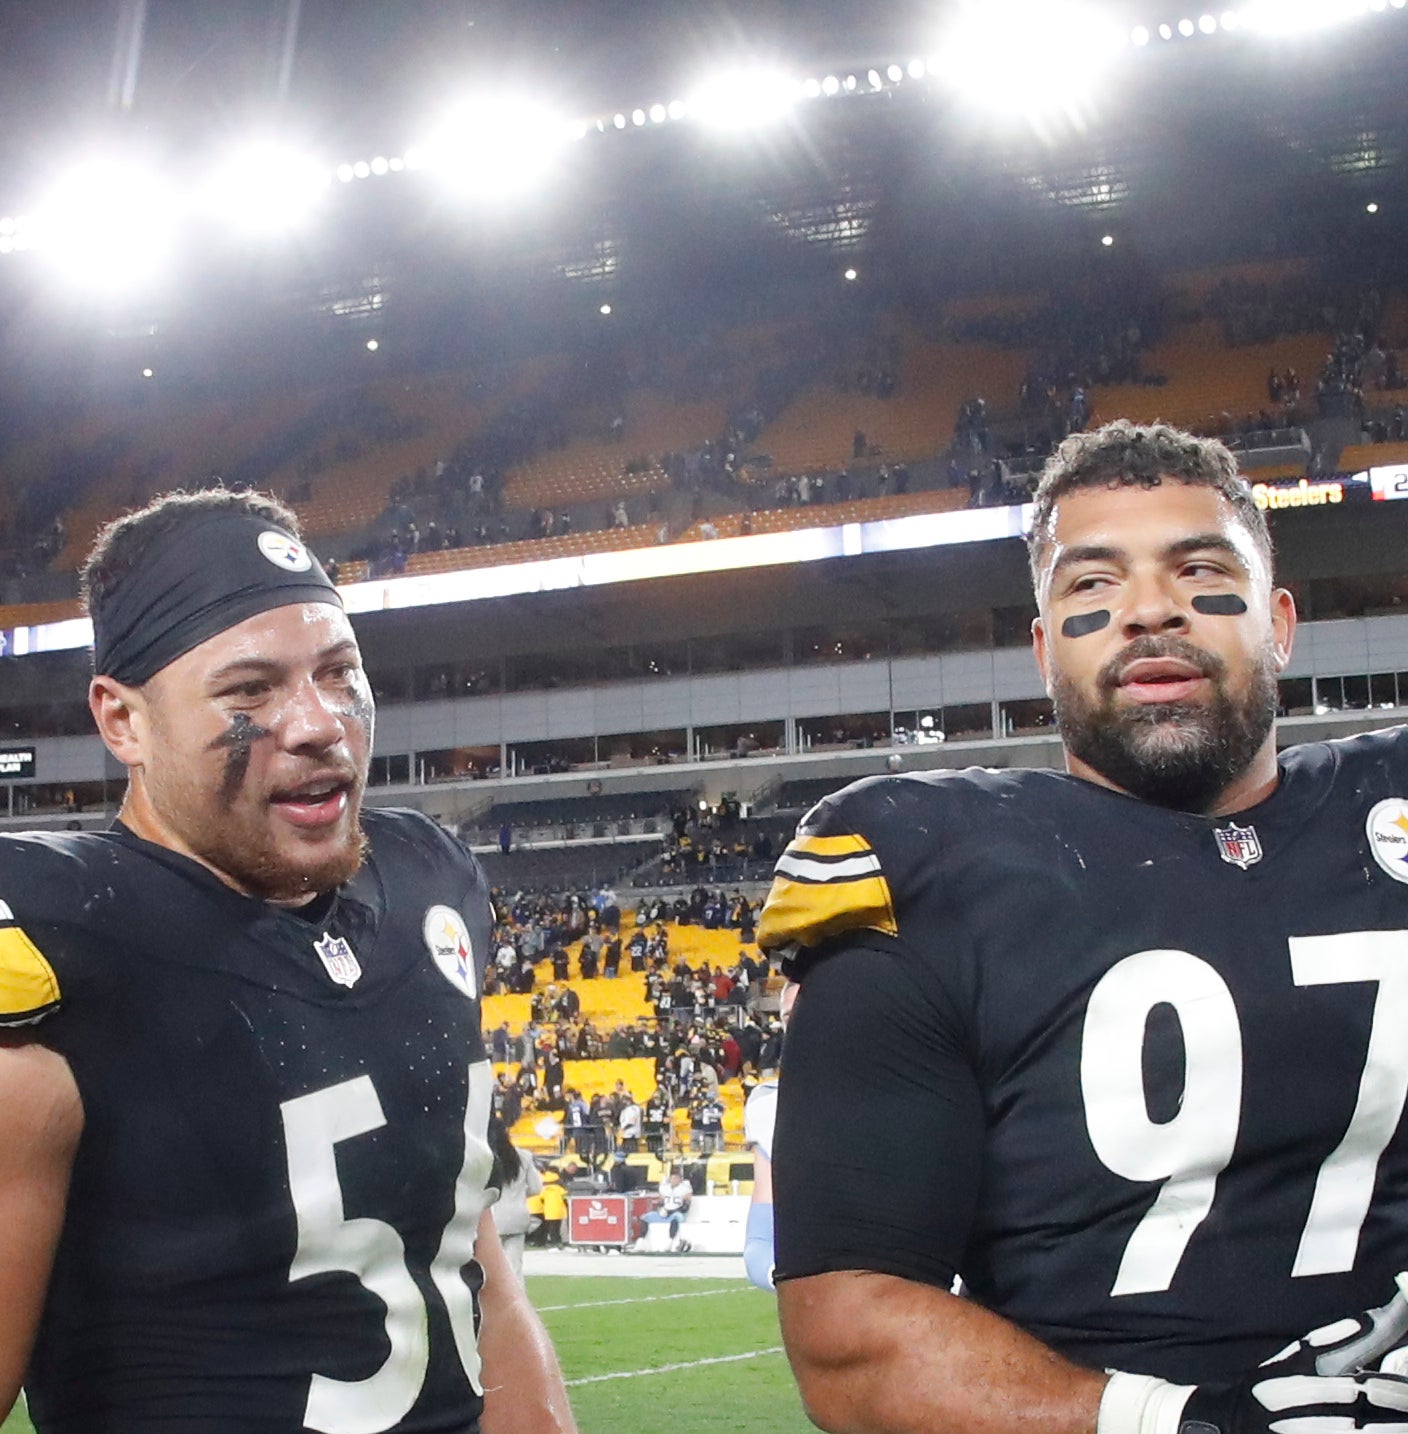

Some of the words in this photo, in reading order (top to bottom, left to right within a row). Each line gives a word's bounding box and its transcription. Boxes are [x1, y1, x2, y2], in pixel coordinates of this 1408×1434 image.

[1252, 479, 1344, 509] Steelers
[1375, 832, 1406, 845] Steelers
[1225, 839, 1256, 861] NFL
